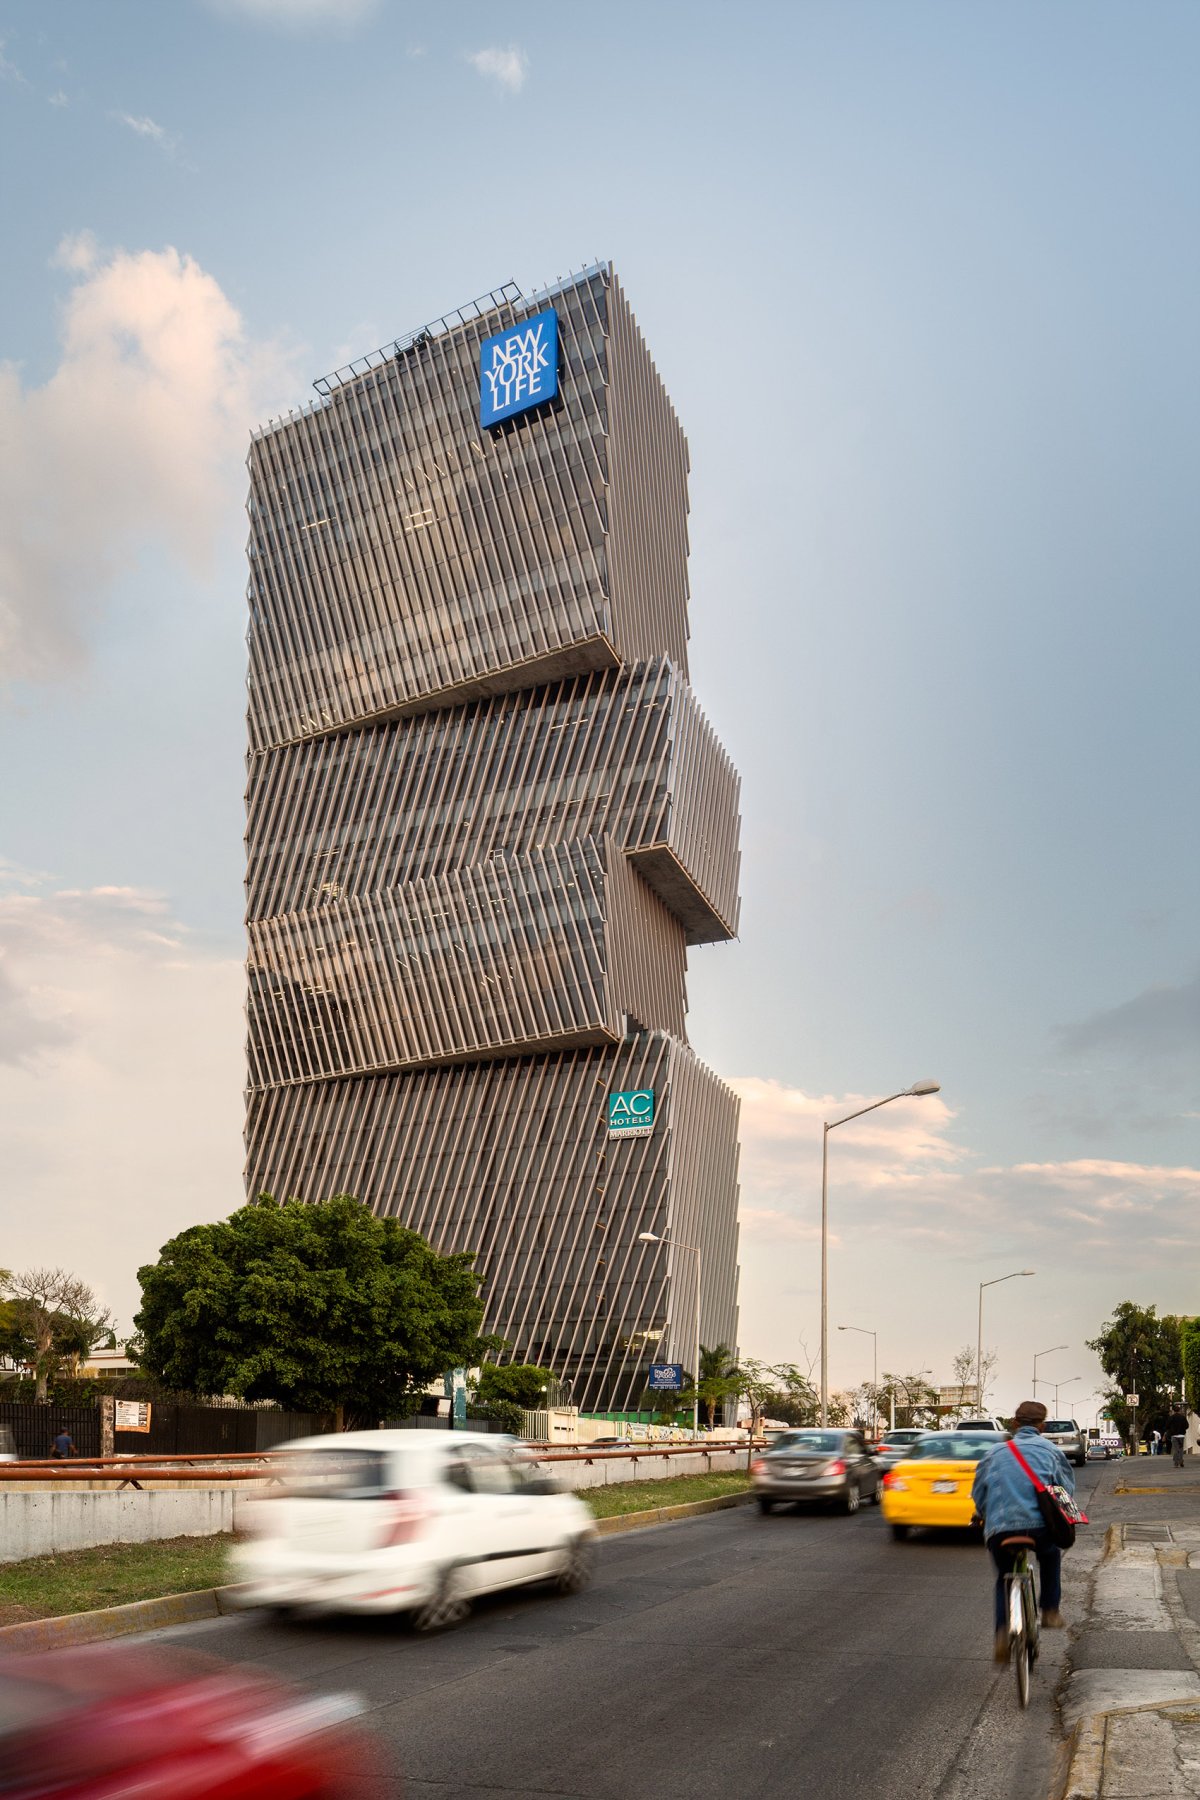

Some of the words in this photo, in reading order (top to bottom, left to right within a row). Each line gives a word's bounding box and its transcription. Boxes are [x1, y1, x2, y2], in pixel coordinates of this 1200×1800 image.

[492, 323, 544, 370] NEW
[484, 342, 549, 392] YORK
[492, 368, 542, 412] LIFE
[610, 1116, 651, 1125] HOTELS
[611, 1093, 650, 1117] AC
[610, 1129, 651, 1137] MARRIOTT
